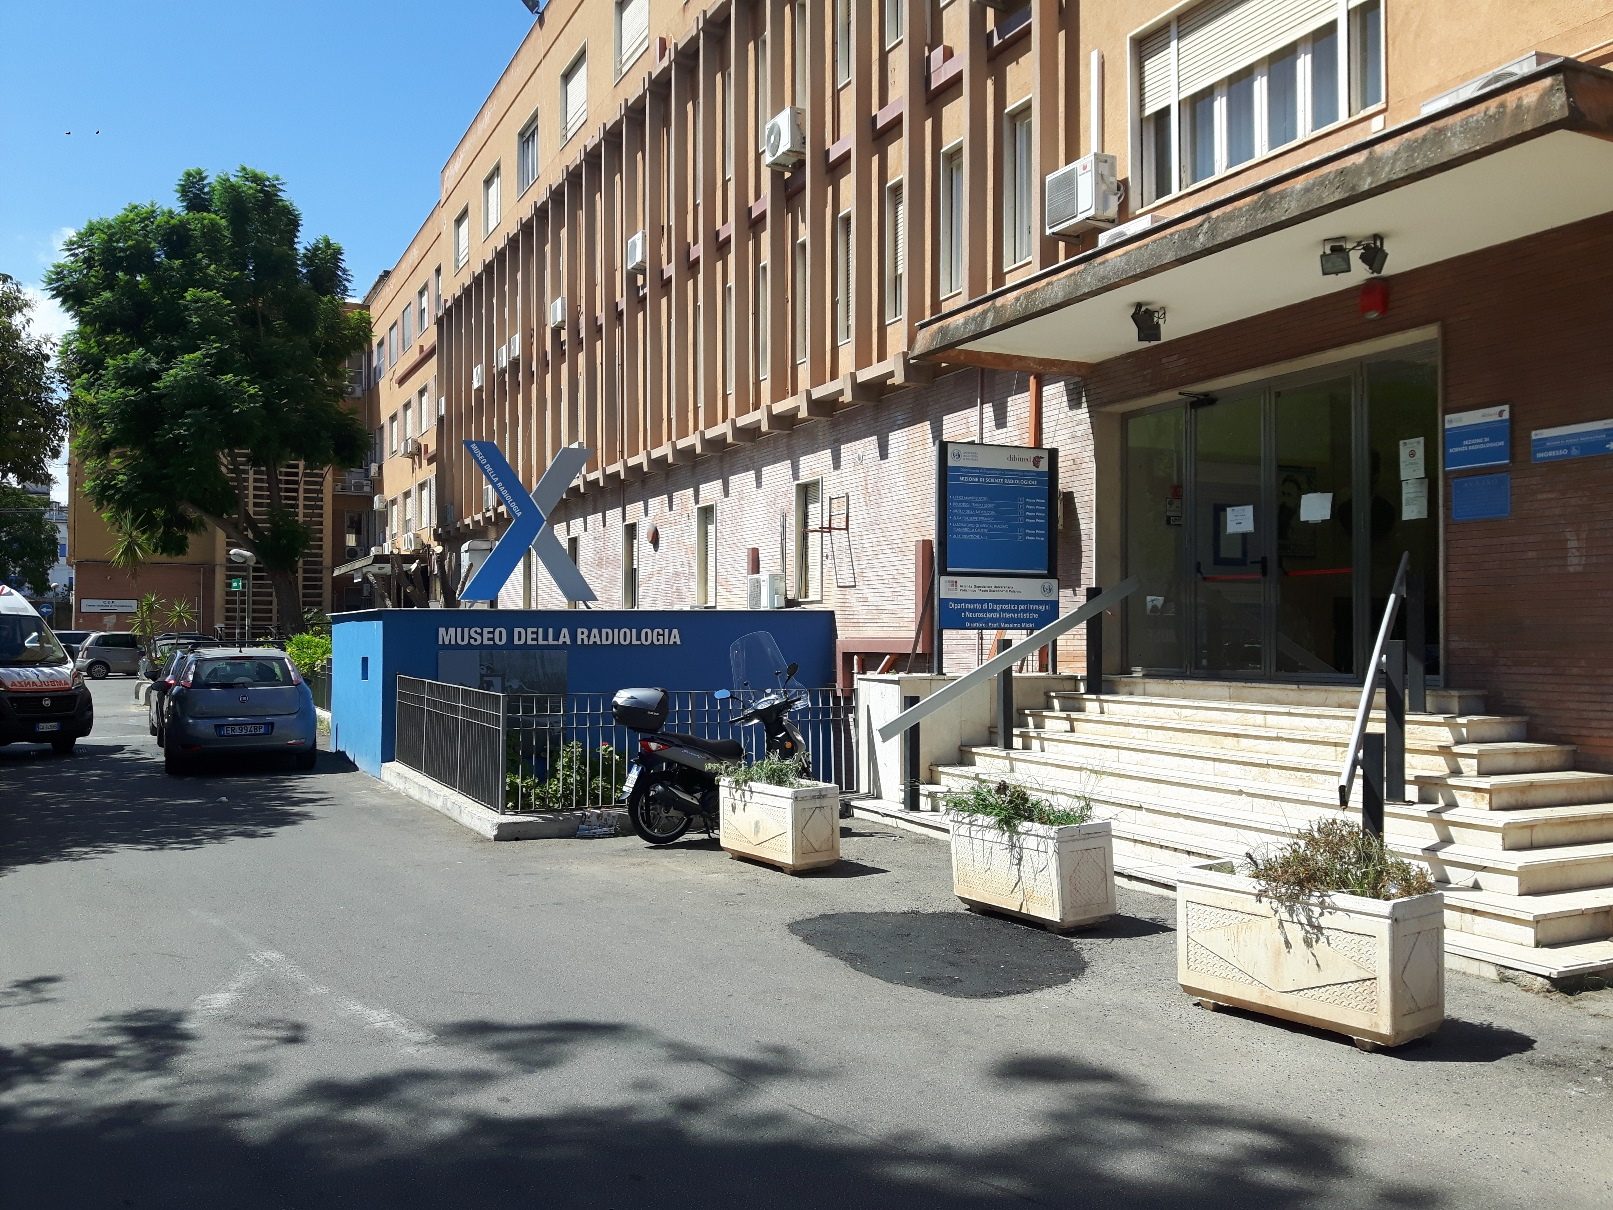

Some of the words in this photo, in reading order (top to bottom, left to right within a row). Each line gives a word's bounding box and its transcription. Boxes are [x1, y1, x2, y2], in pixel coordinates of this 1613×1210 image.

[1536, 448, 1568, 458] INGRESSO
[470, 443, 487, 465] MUSEO
[484, 463, 499, 483] DELLA
[496, 481, 522, 517] RADIOLOGIA
[949, 602, 981, 610] Dipartimento
[988, 603, 1018, 611] Diagnostica
[1028, 603, 1050, 612] Immagini
[438, 627, 507, 645] MUSEO
[513, 627, 571, 645] DELLA
[577, 628, 681, 645] RADIOLOGIA
[226, 726, 236, 734] ER
